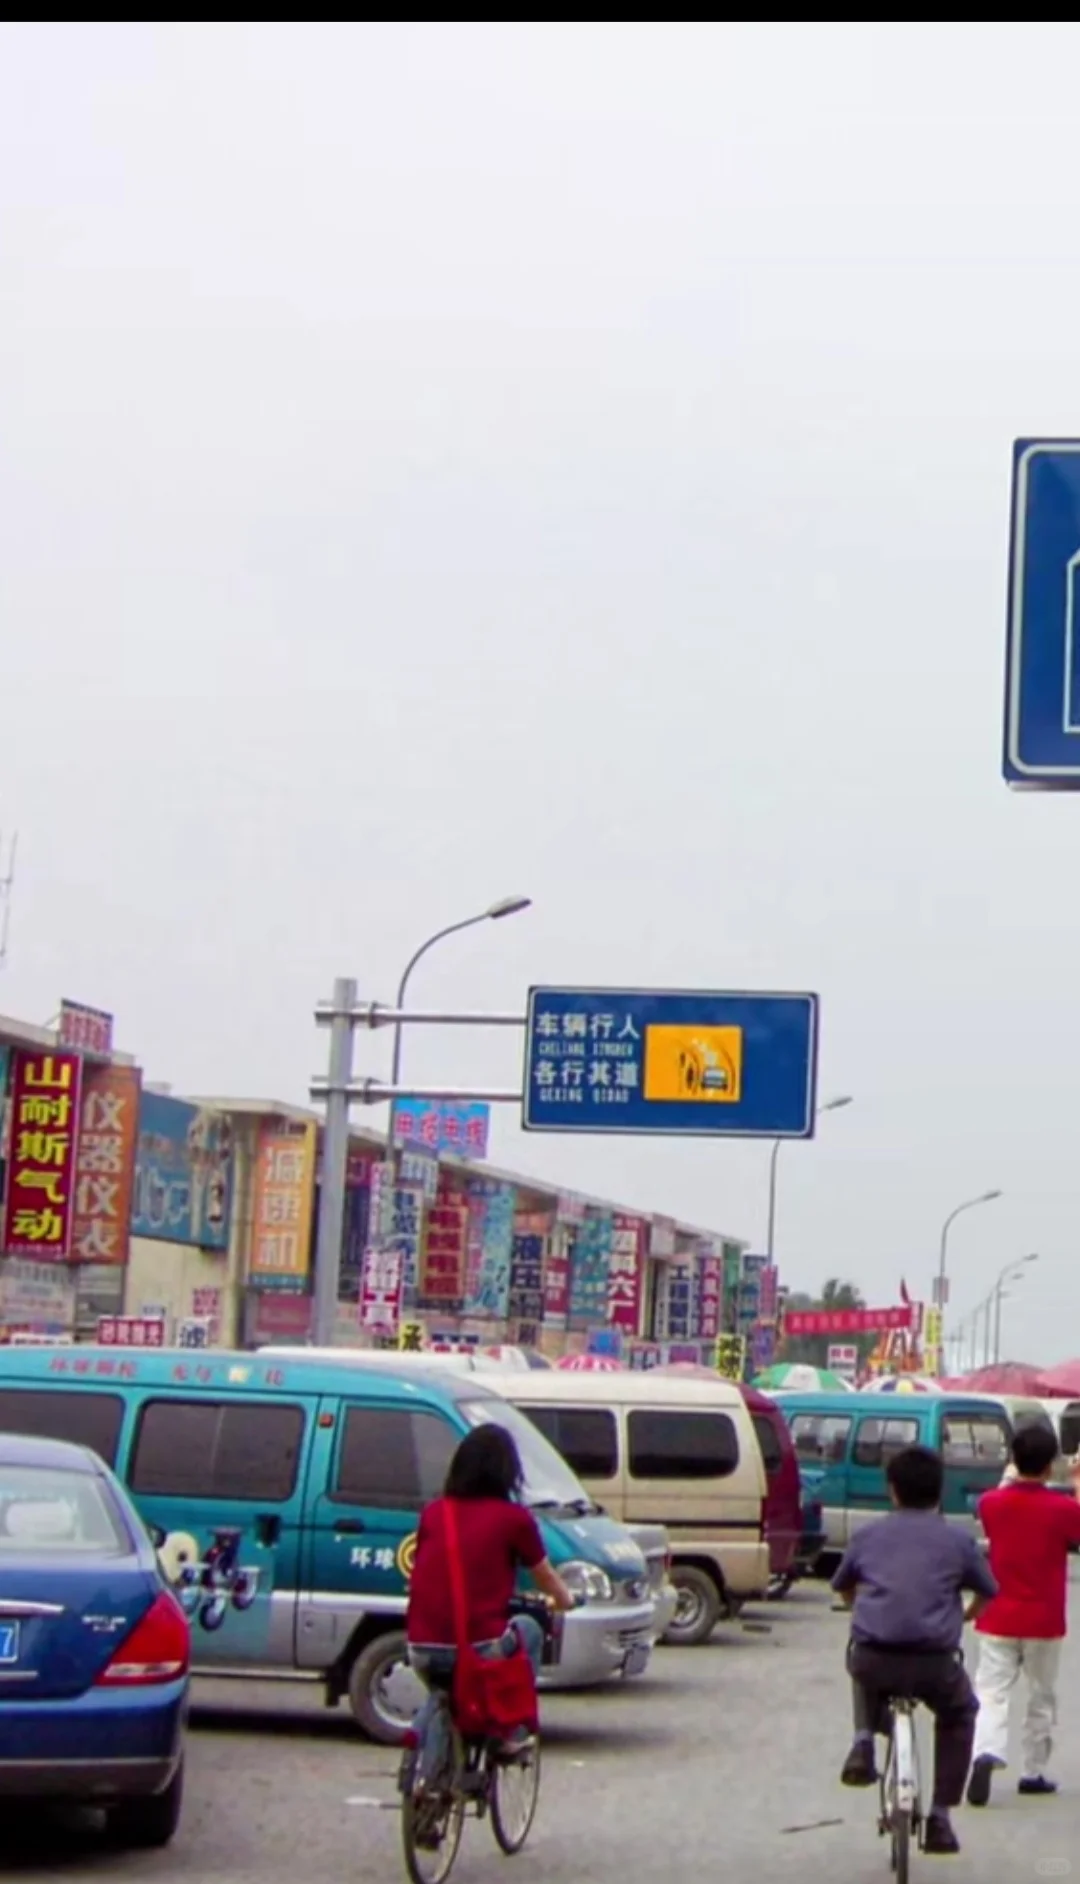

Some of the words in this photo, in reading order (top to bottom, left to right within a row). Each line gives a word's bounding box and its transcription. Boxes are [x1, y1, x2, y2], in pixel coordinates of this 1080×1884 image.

[536, 1011, 640, 1039] 车辆行人
[534, 1059, 638, 1087] 各行其道
[13, 1057, 71, 1240] 山耐斯气动
[74, 1091, 126, 1258] 仪器仪表
[350, 1547, 395, 1570] 环球
